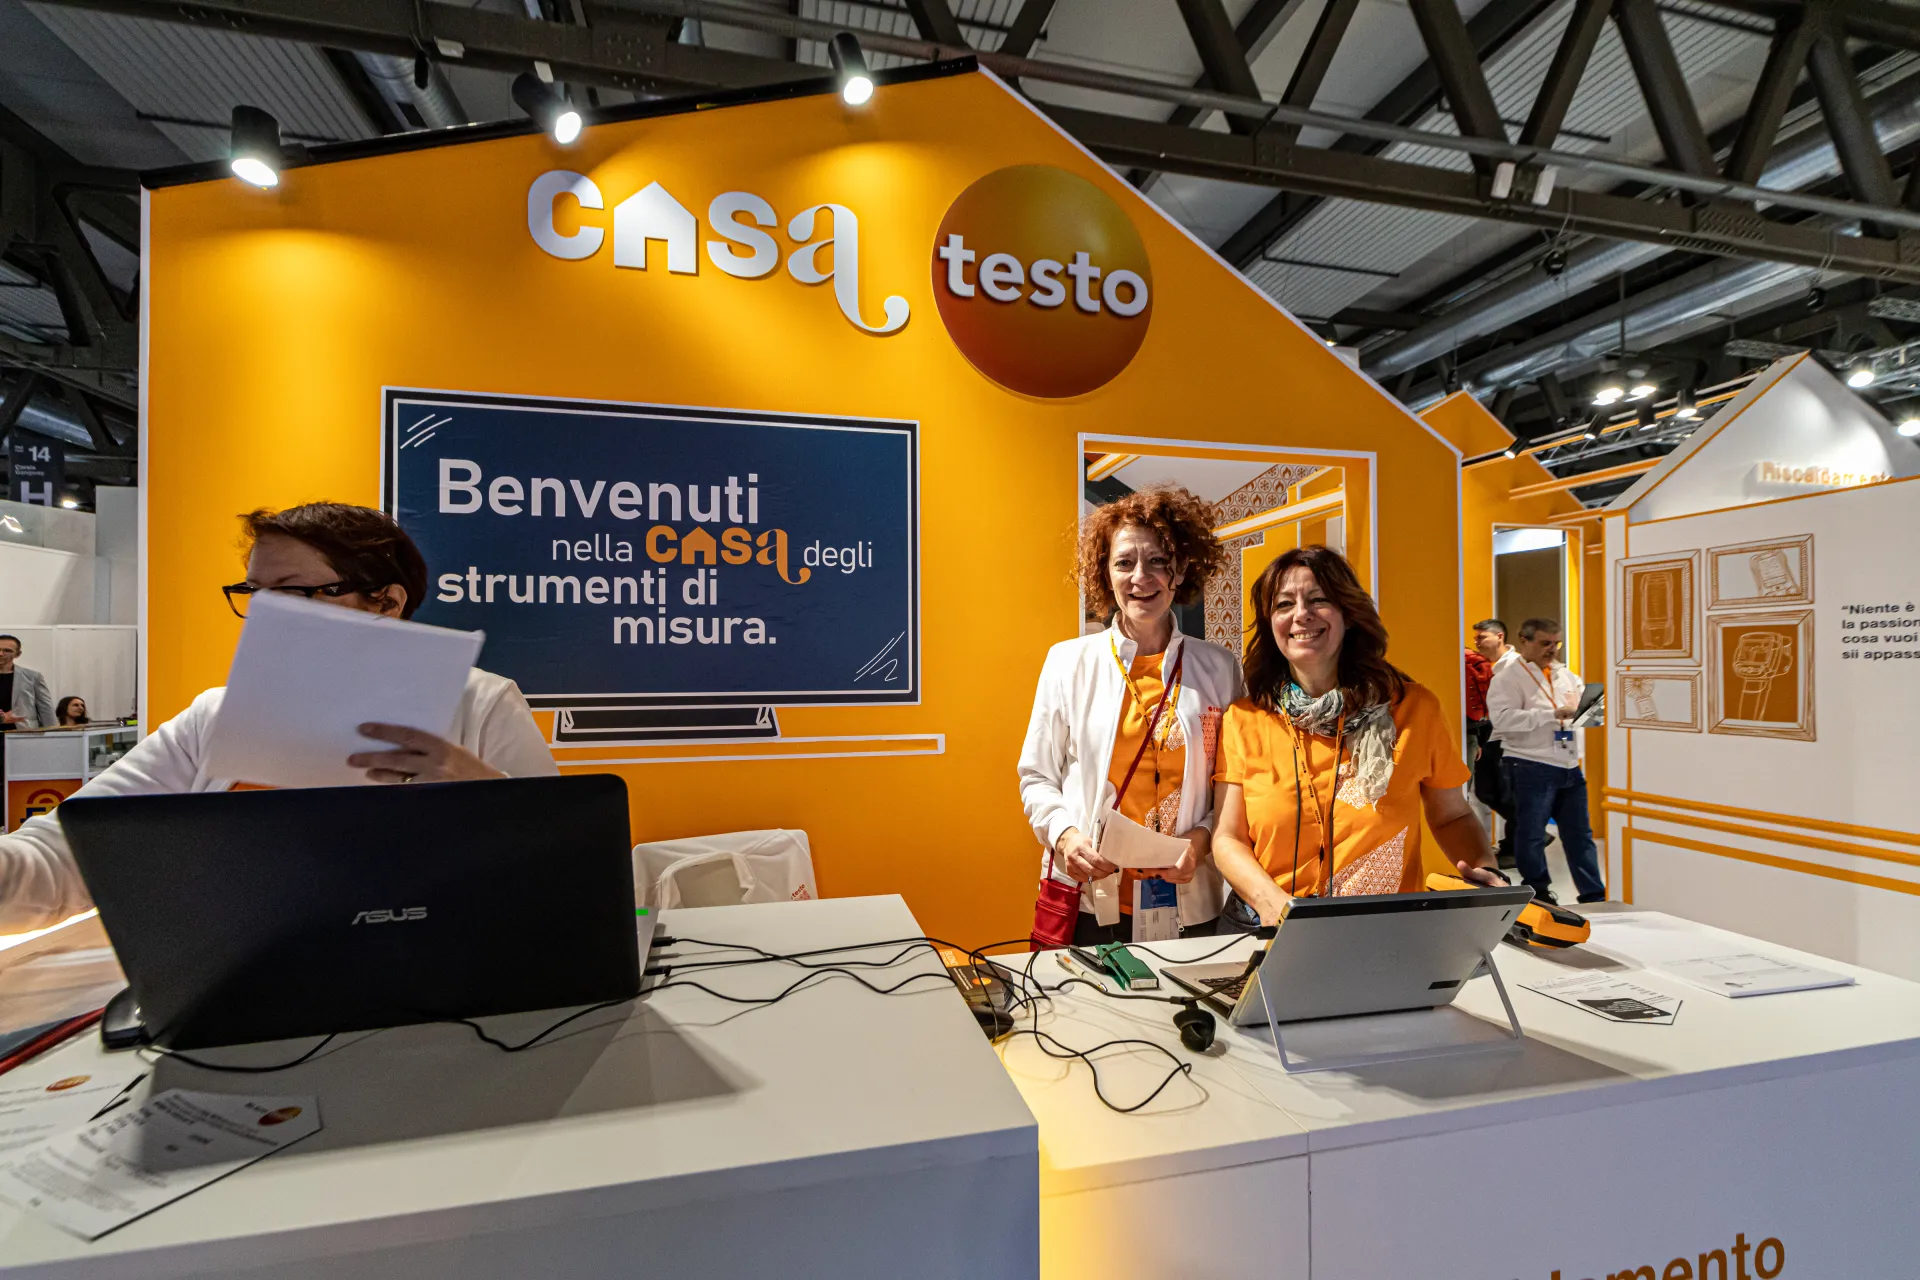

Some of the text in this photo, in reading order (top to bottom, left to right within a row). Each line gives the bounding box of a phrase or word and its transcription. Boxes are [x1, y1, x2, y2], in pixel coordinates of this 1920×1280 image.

[940, 234, 1148, 317] testo
[28, 446, 51, 462] 14
[21, 481, 52, 507] H
[438, 458, 759, 524] Benvenuti
[552, 533, 633, 562] nella
[803, 540, 873, 574] degli
[437, 566, 718, 606] strumenti di
[1841, 601, 1915, 614] “Niente è
[613, 607, 777, 645] misura.
[1842, 617, 1920, 631] la passion
[1842, 632, 1918, 643] cosa vuoi
[1842, 649, 1920, 661] sii appass
[351, 906, 427, 925] ASUS
